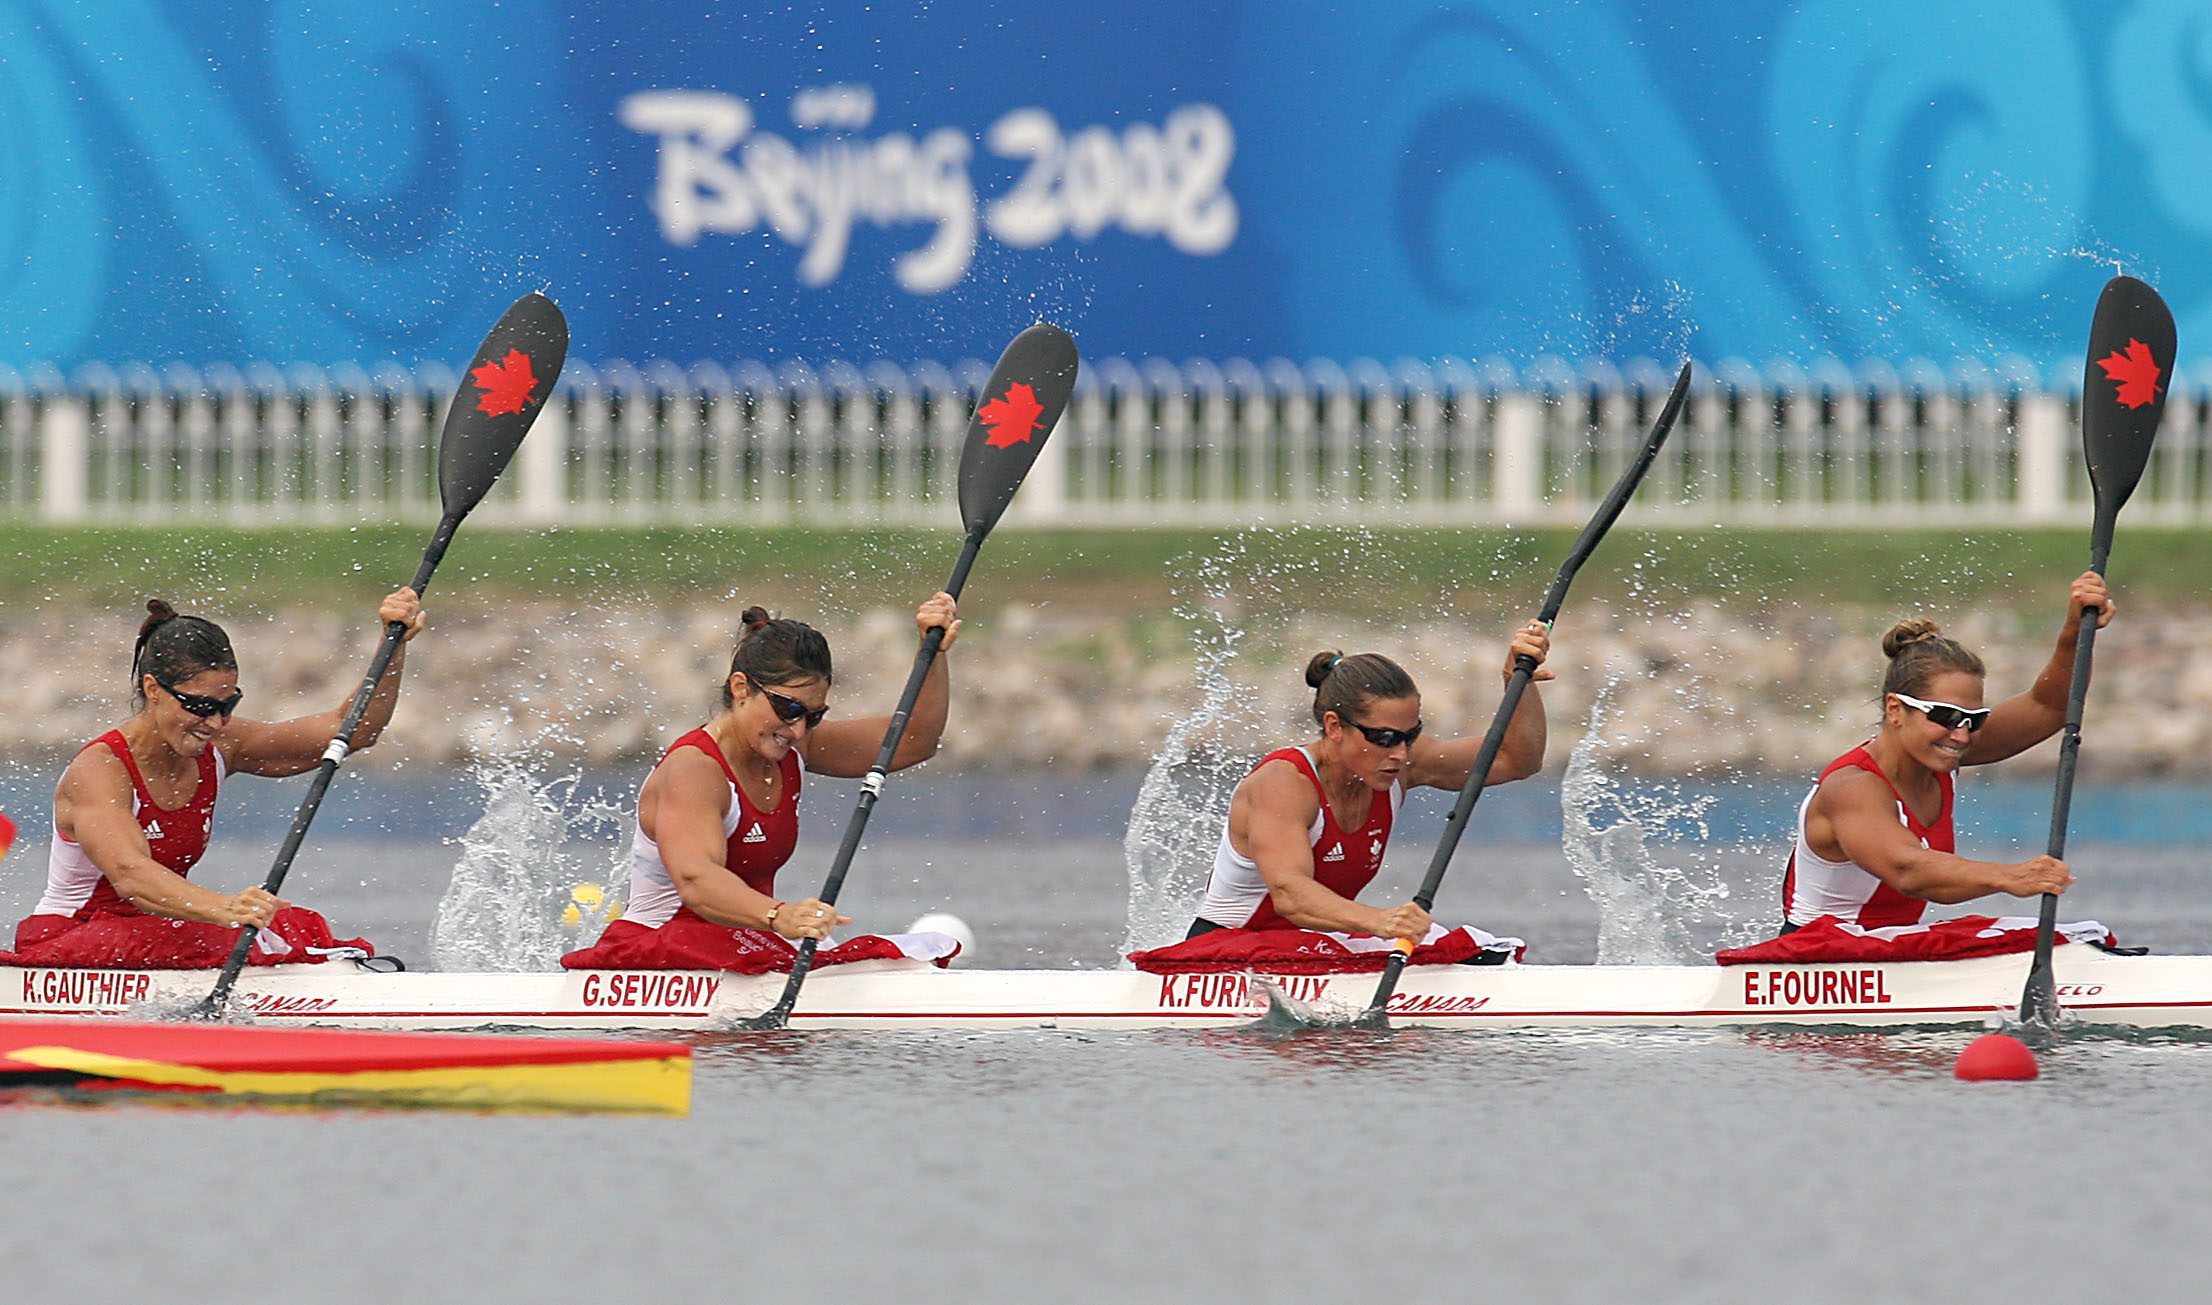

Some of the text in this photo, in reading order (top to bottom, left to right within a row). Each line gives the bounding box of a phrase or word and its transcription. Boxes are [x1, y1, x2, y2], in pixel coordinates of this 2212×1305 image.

[621, 86, 1239, 293] Beijing 2008
[23, 970, 150, 1005] K.GAUTHIER
[583, 973, 719, 1007] G.SEVIGNY
[1384, 993, 1490, 1011] CANADA
[1745, 970, 1891, 1005] E.FOURNEL
